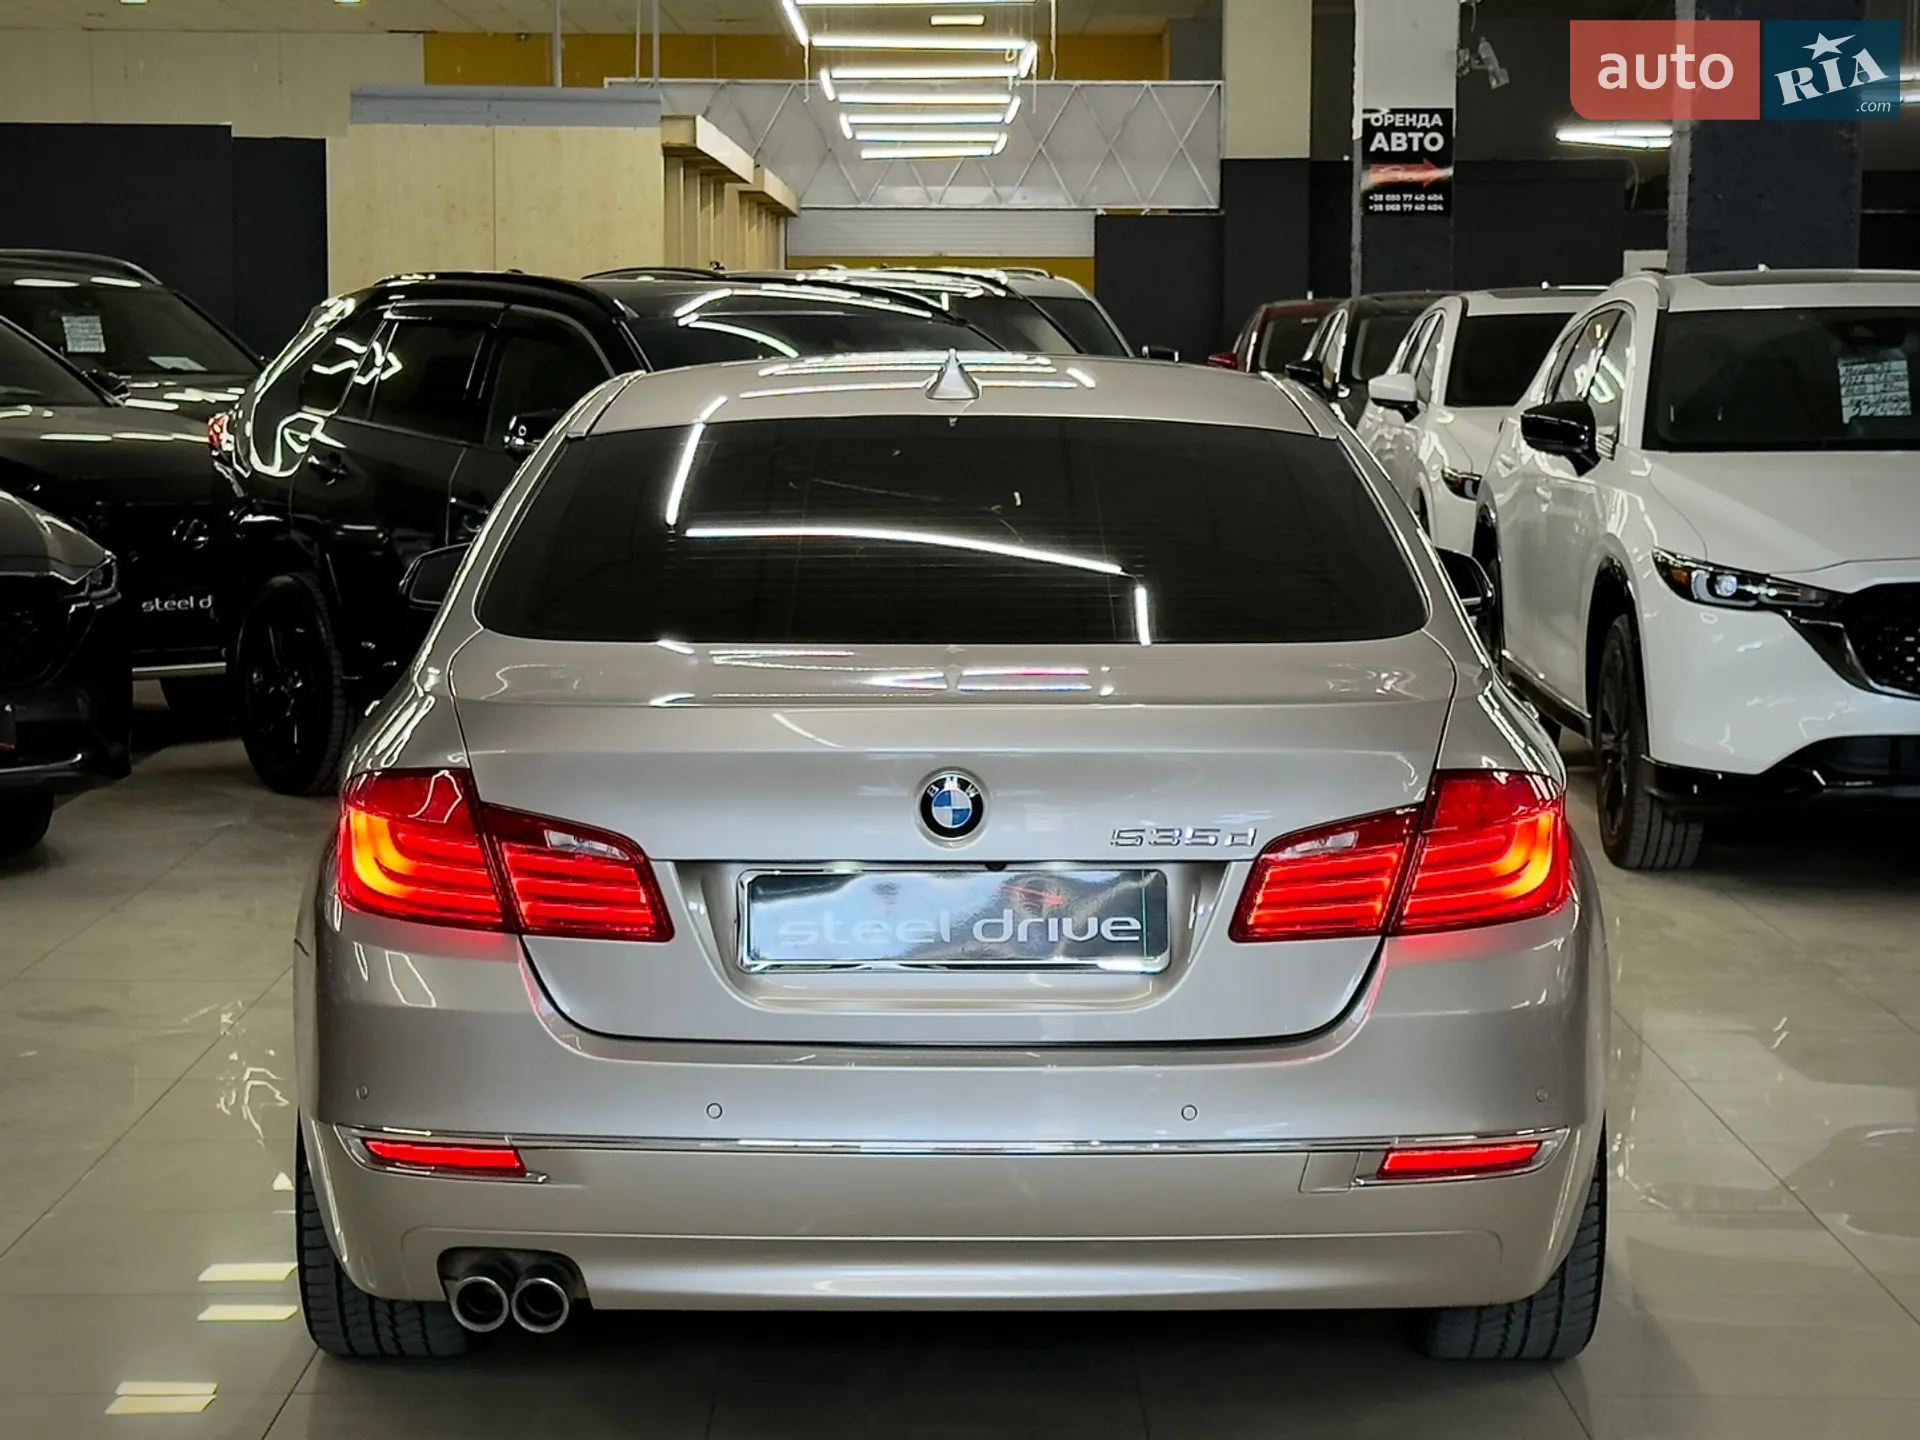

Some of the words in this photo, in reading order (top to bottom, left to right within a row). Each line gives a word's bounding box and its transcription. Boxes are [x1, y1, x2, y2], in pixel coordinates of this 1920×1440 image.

[1370, 113, 1443, 128] ОРЕНДА
[1369, 132, 1444, 152] АВТО
[141, 595, 194, 612] steel
[1110, 827, 1258, 847] 535d
[778, 909, 952, 946] steel
[973, 908, 1142, 944] drive
